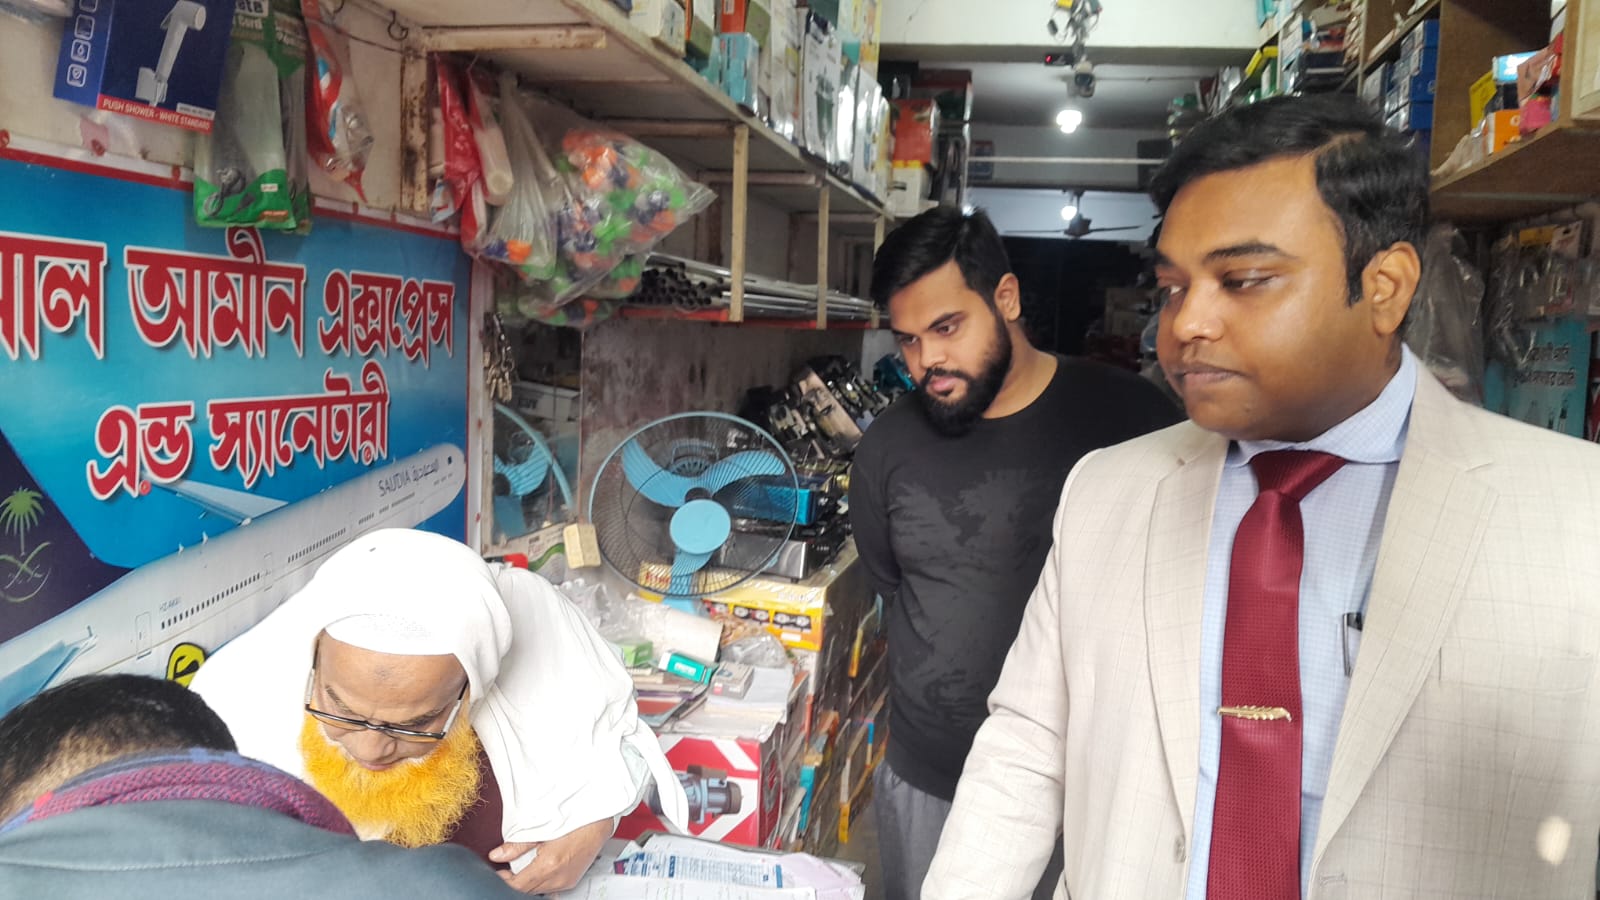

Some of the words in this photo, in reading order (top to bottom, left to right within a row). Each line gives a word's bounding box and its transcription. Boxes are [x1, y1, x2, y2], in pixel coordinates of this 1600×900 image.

[103, 98, 125, 112] PUSH
[125, 102, 154, 118] SHOWER
[160, 111, 180, 123] WHITE
[180, 116, 210, 130] STANDARD
[123, 225, 307, 359] আমীন
[317, 268, 455, 369] এক্সপ্রেস
[86, 401, 195, 500] এন্ড
[207, 358, 389, 489] স্যানেটারী
[378, 469, 411, 497] SAUDIA
